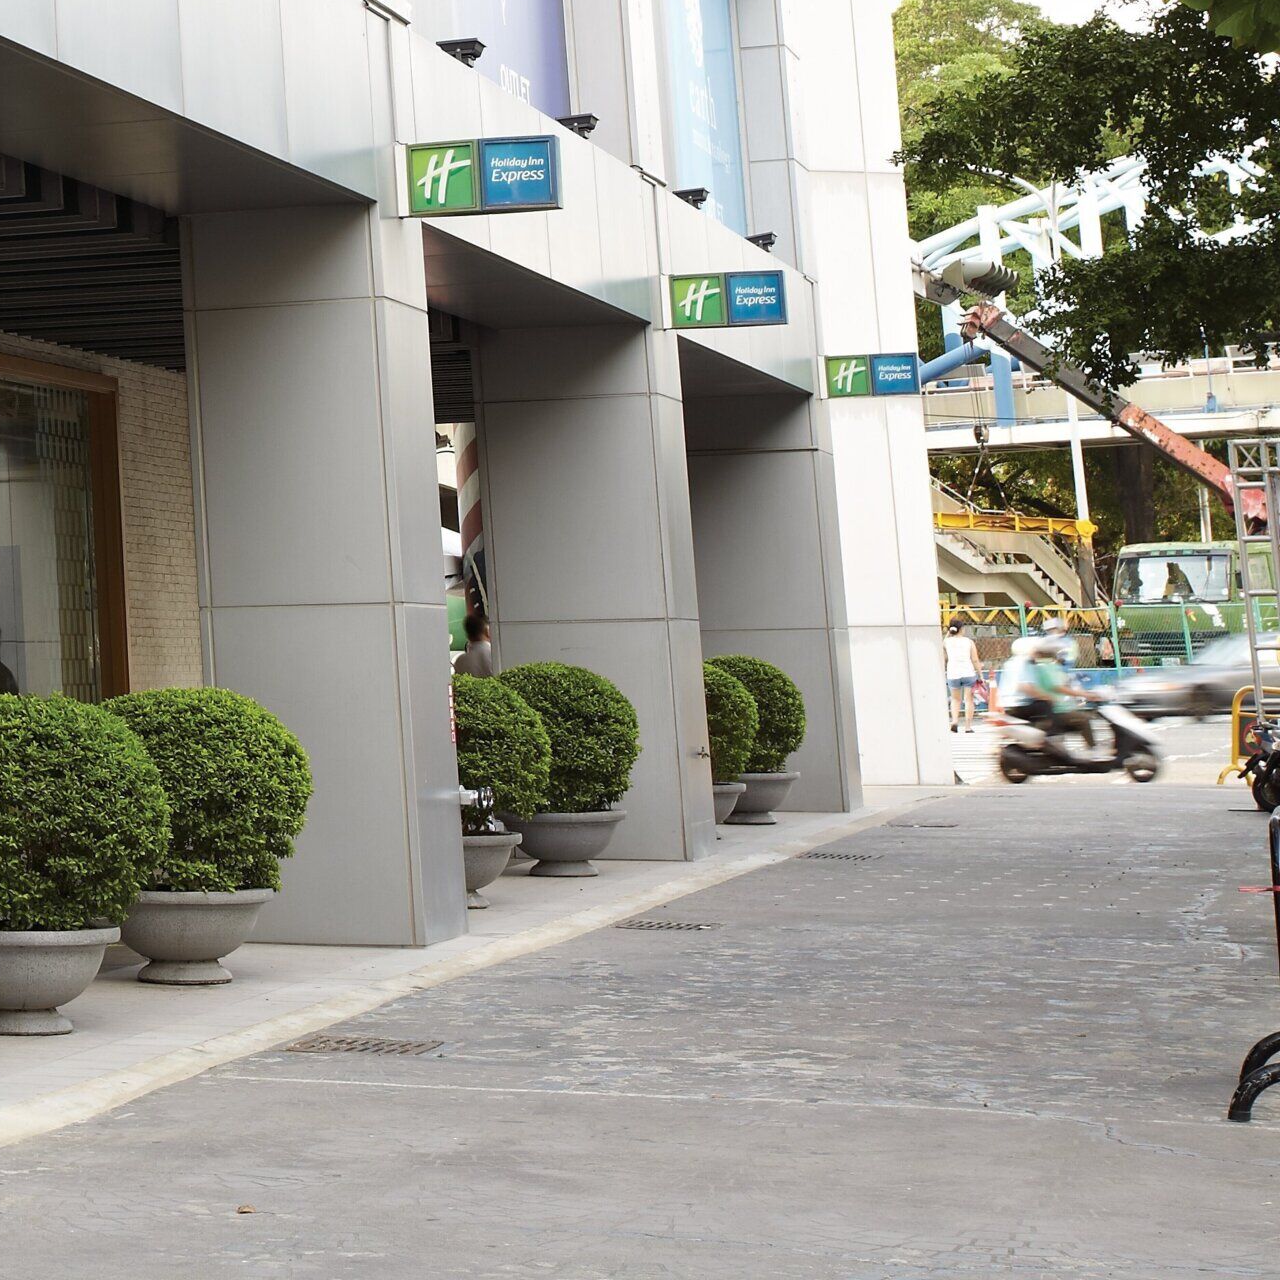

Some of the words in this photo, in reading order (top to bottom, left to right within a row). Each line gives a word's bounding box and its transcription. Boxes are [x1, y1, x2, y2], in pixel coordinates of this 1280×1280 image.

[500, 64, 531, 105] OUTLET
[491, 156, 527, 168] Holiday
[528, 156, 544, 166] Inn
[491, 169, 545, 184] Express
[735, 286, 763, 294] Holiday
[763, 285, 776, 293] Inn
[736, 295, 776, 307] Express
